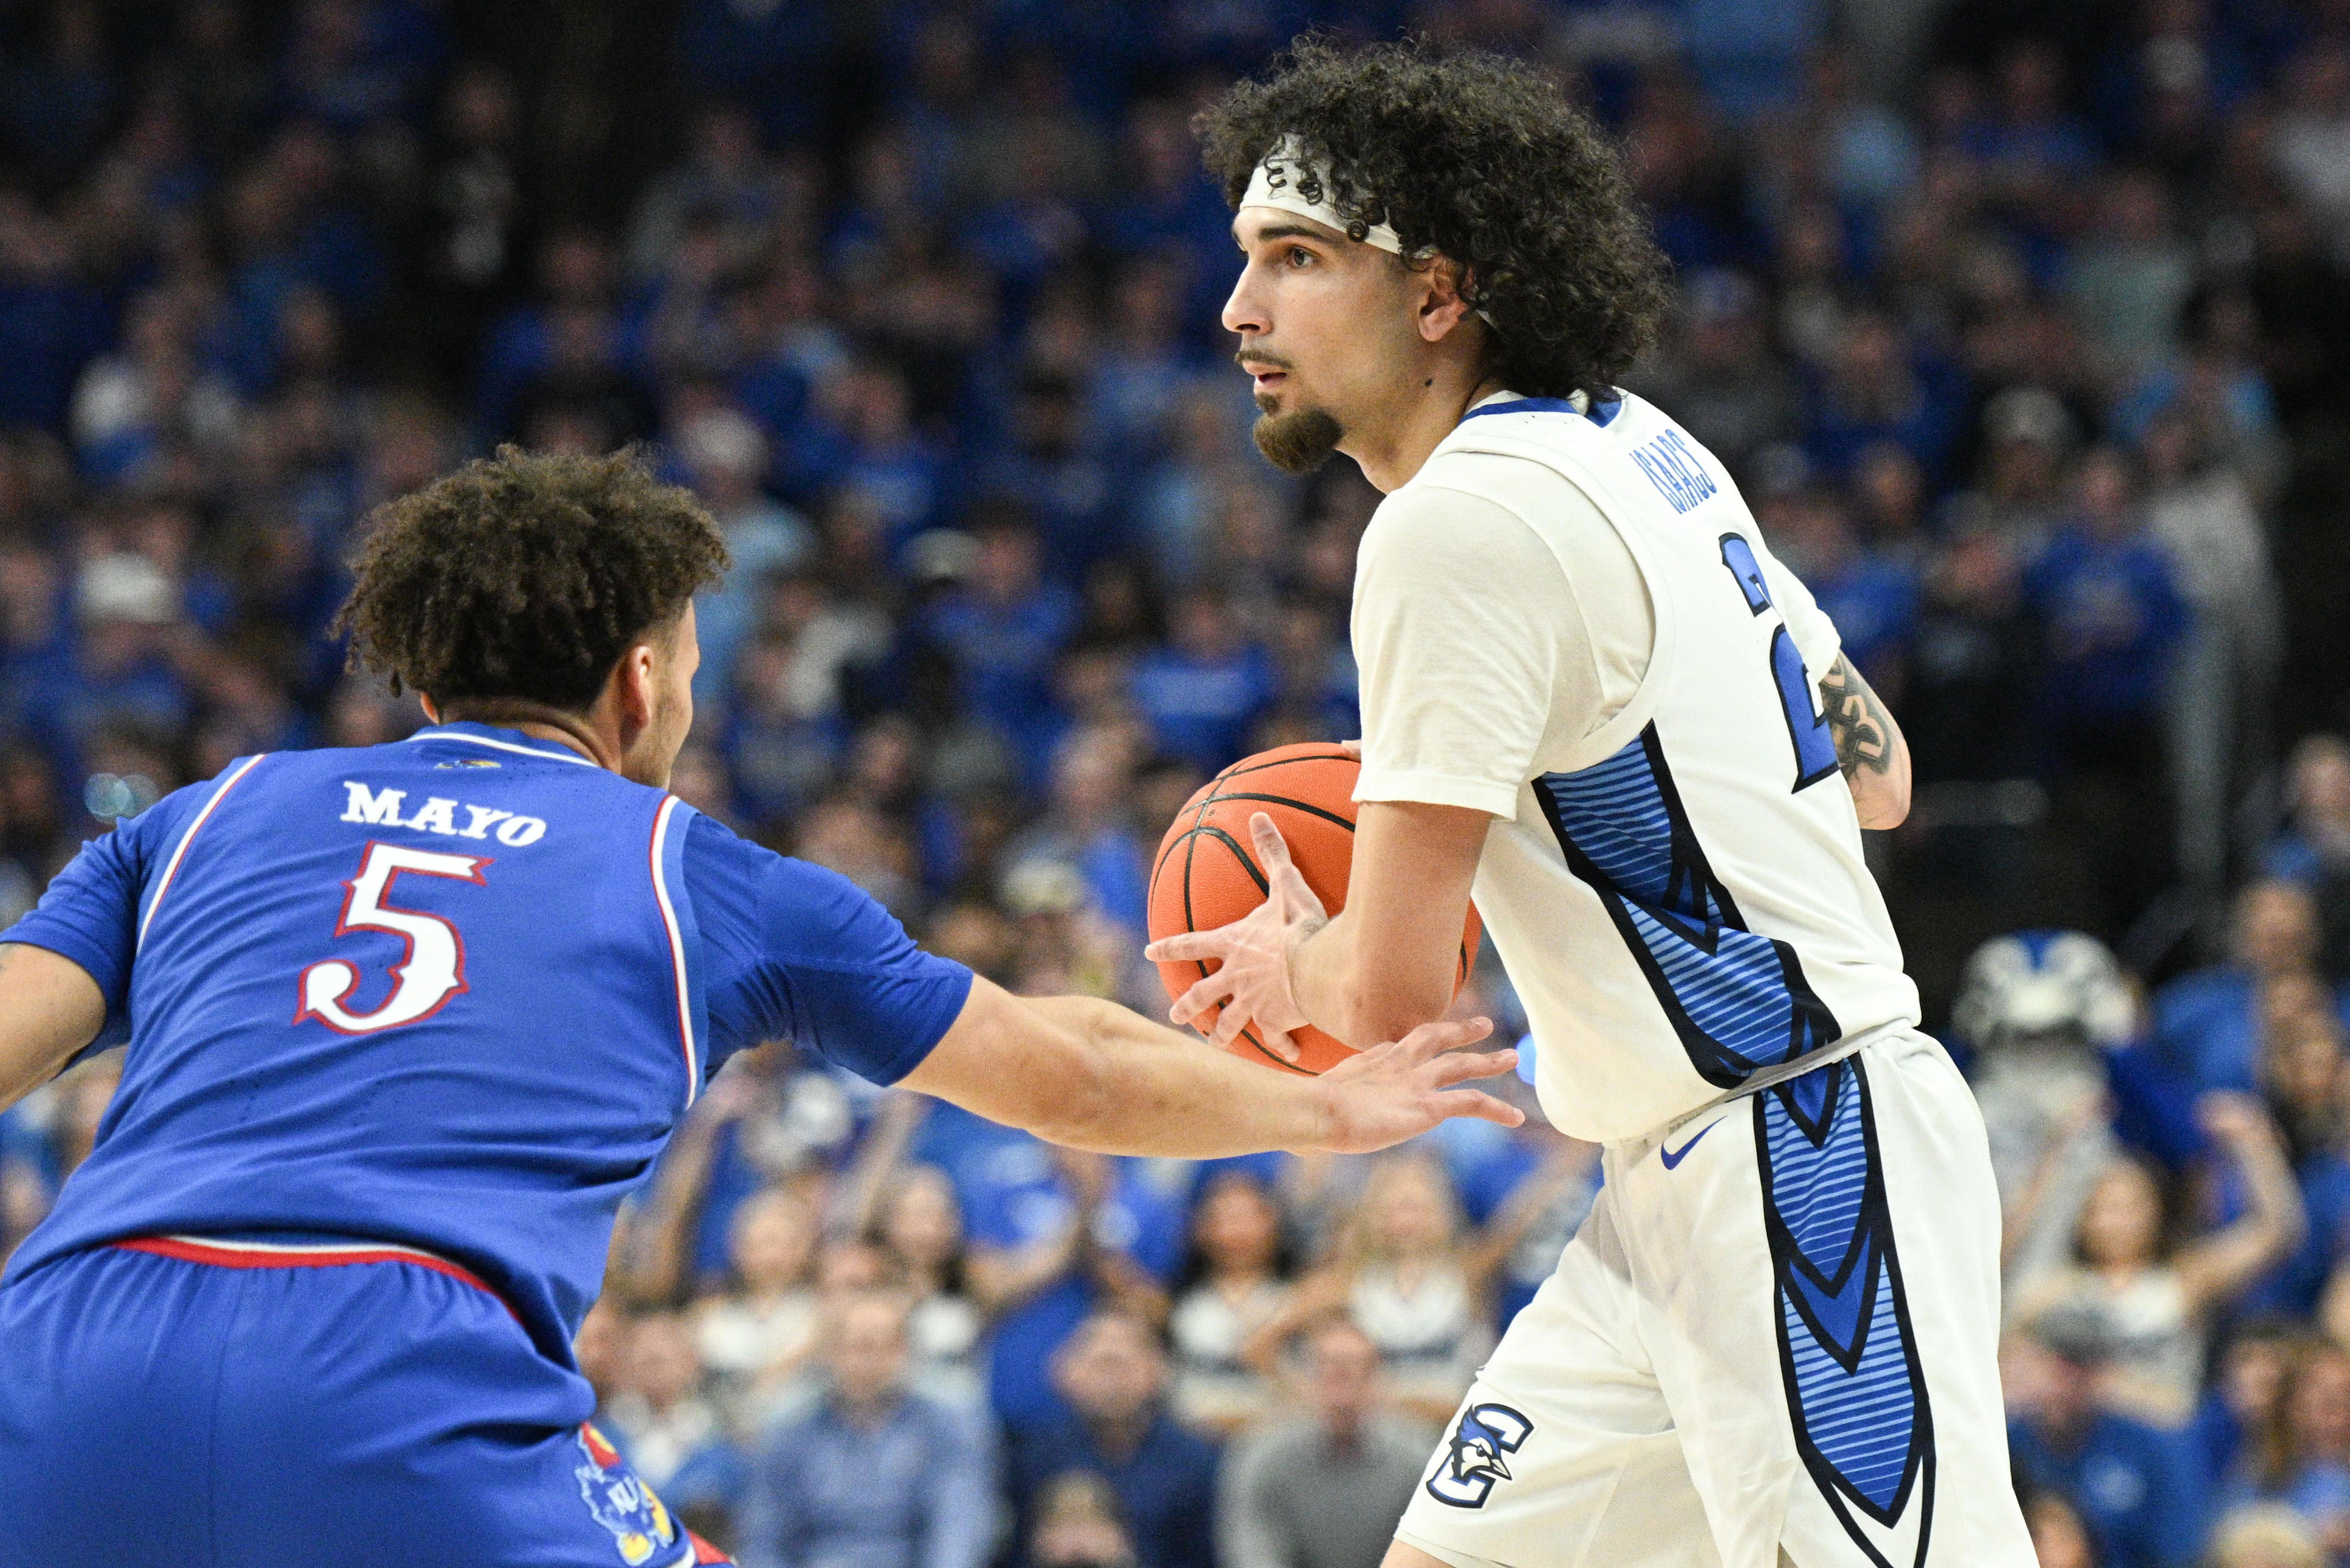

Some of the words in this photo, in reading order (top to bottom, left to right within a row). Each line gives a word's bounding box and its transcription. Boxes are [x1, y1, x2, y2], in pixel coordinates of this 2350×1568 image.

[1629, 429, 1717, 514] ISAACS
[1718, 532, 1840, 795] 2
[340, 781, 547, 847] MAYO
[292, 840, 496, 1035] 5
